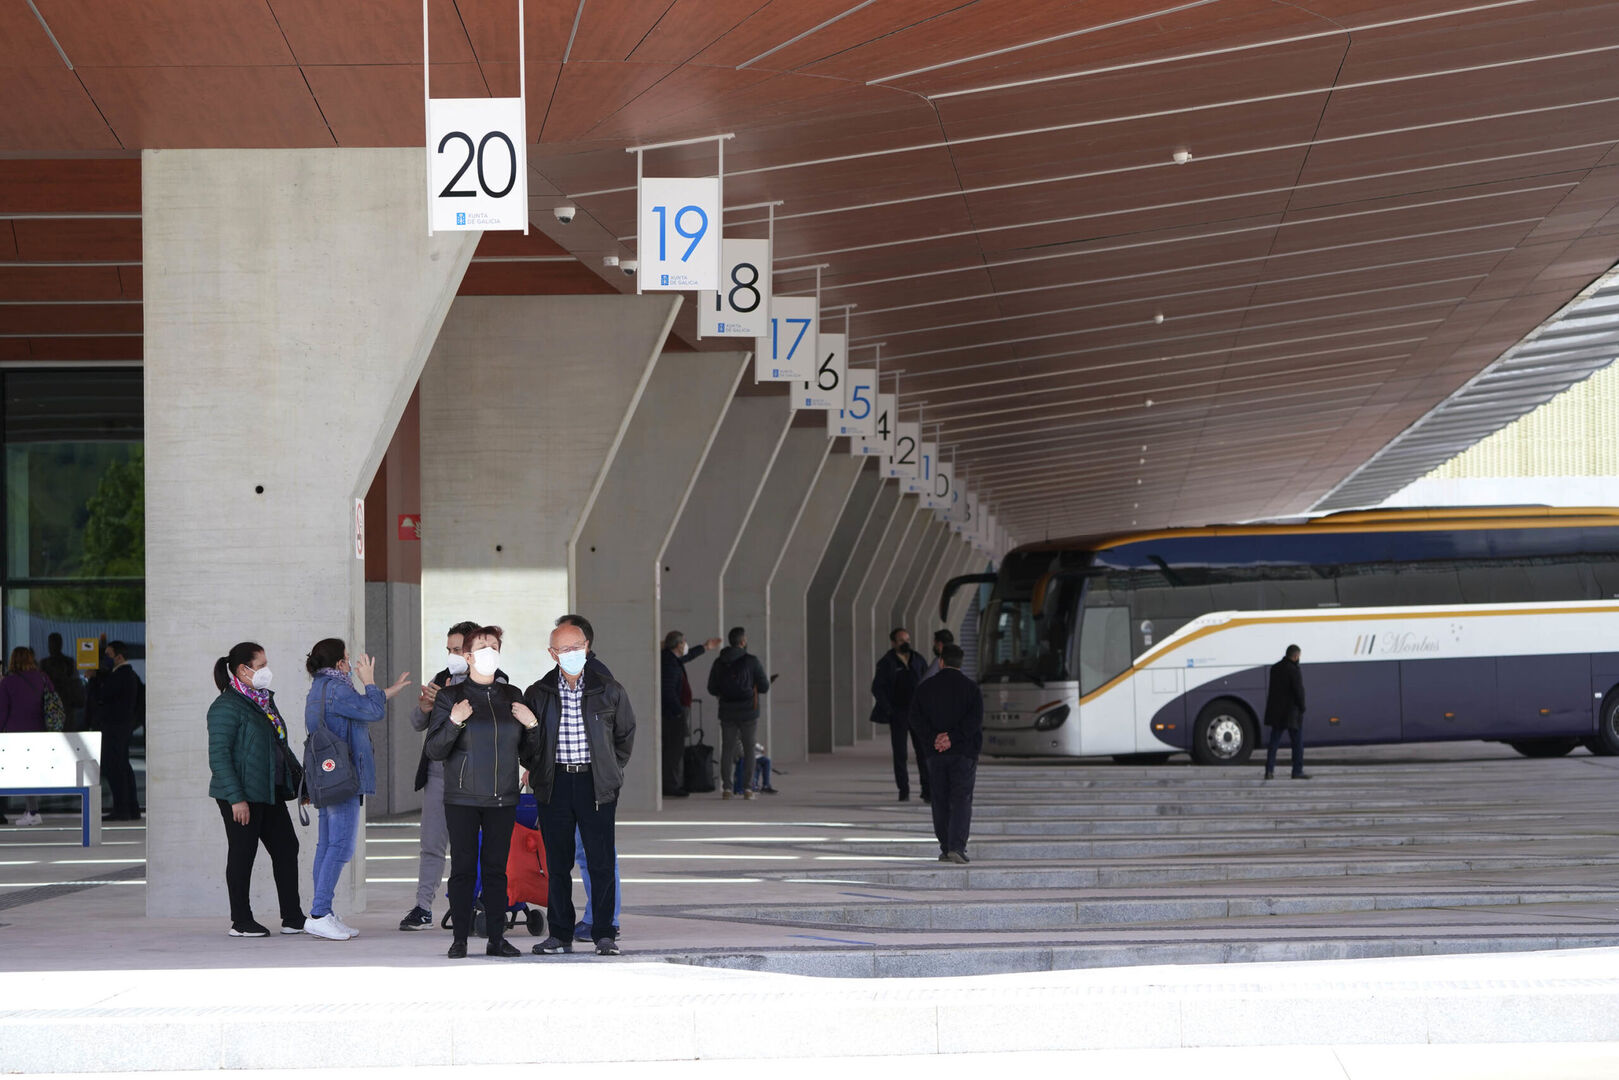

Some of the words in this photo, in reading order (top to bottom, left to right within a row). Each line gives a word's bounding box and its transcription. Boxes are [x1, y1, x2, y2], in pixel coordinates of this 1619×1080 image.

[438, 131, 518, 199] 20
[652, 205, 709, 263] 19
[771, 318, 812, 360] 17
[804, 352, 839, 391] 6
[840, 385, 871, 419] 5
[862, 410, 891, 441] 4
[889, 436, 916, 465] 2
